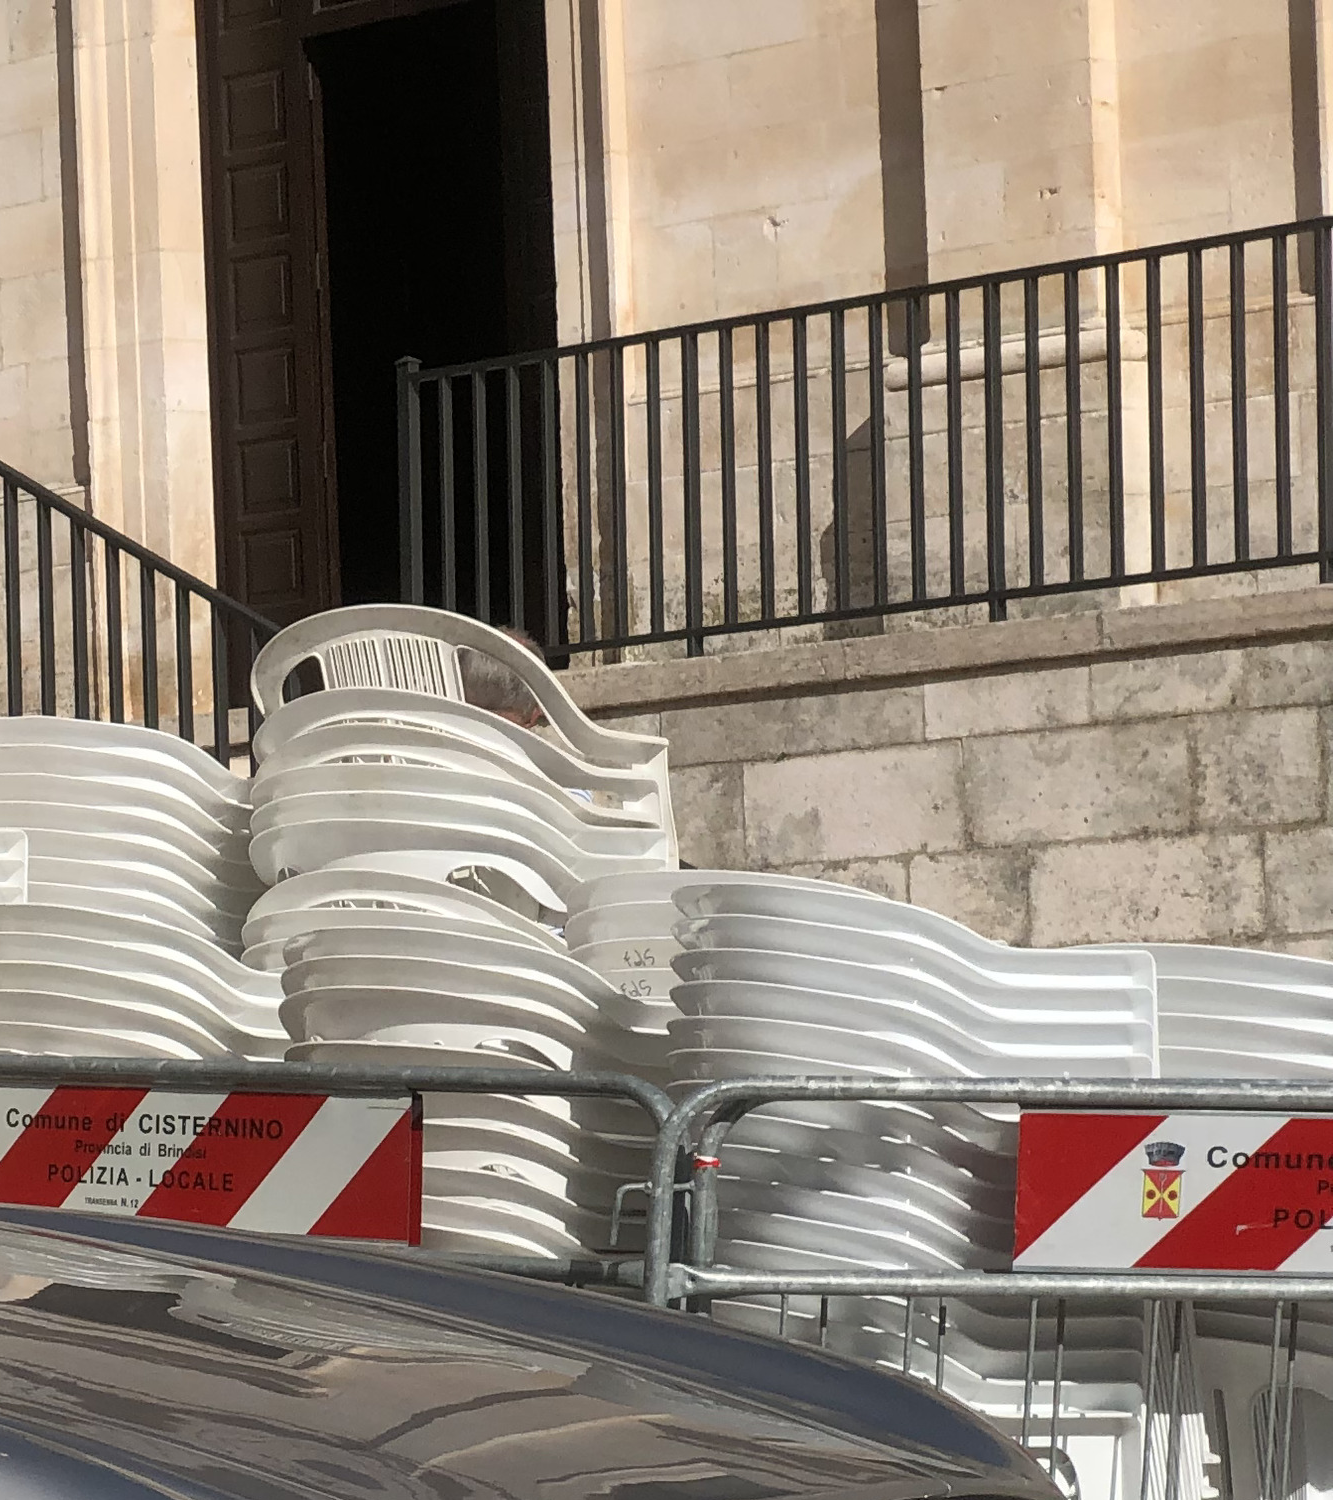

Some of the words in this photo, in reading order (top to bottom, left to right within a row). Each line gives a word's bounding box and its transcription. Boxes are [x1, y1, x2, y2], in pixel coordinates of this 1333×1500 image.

[6, 1107, 92, 1132] Comune
[106, 1112, 126, 1133] di
[138, 1113, 284, 1140] CISTERNINO
[74, 1139, 133, 1156] Provincia
[139, 1142, 151, 1157] di
[158, 1143, 207, 1160] Brindisi
[47, 1164, 130, 1187] POLIZIA
[149, 1168, 235, 1193] LOCALE
